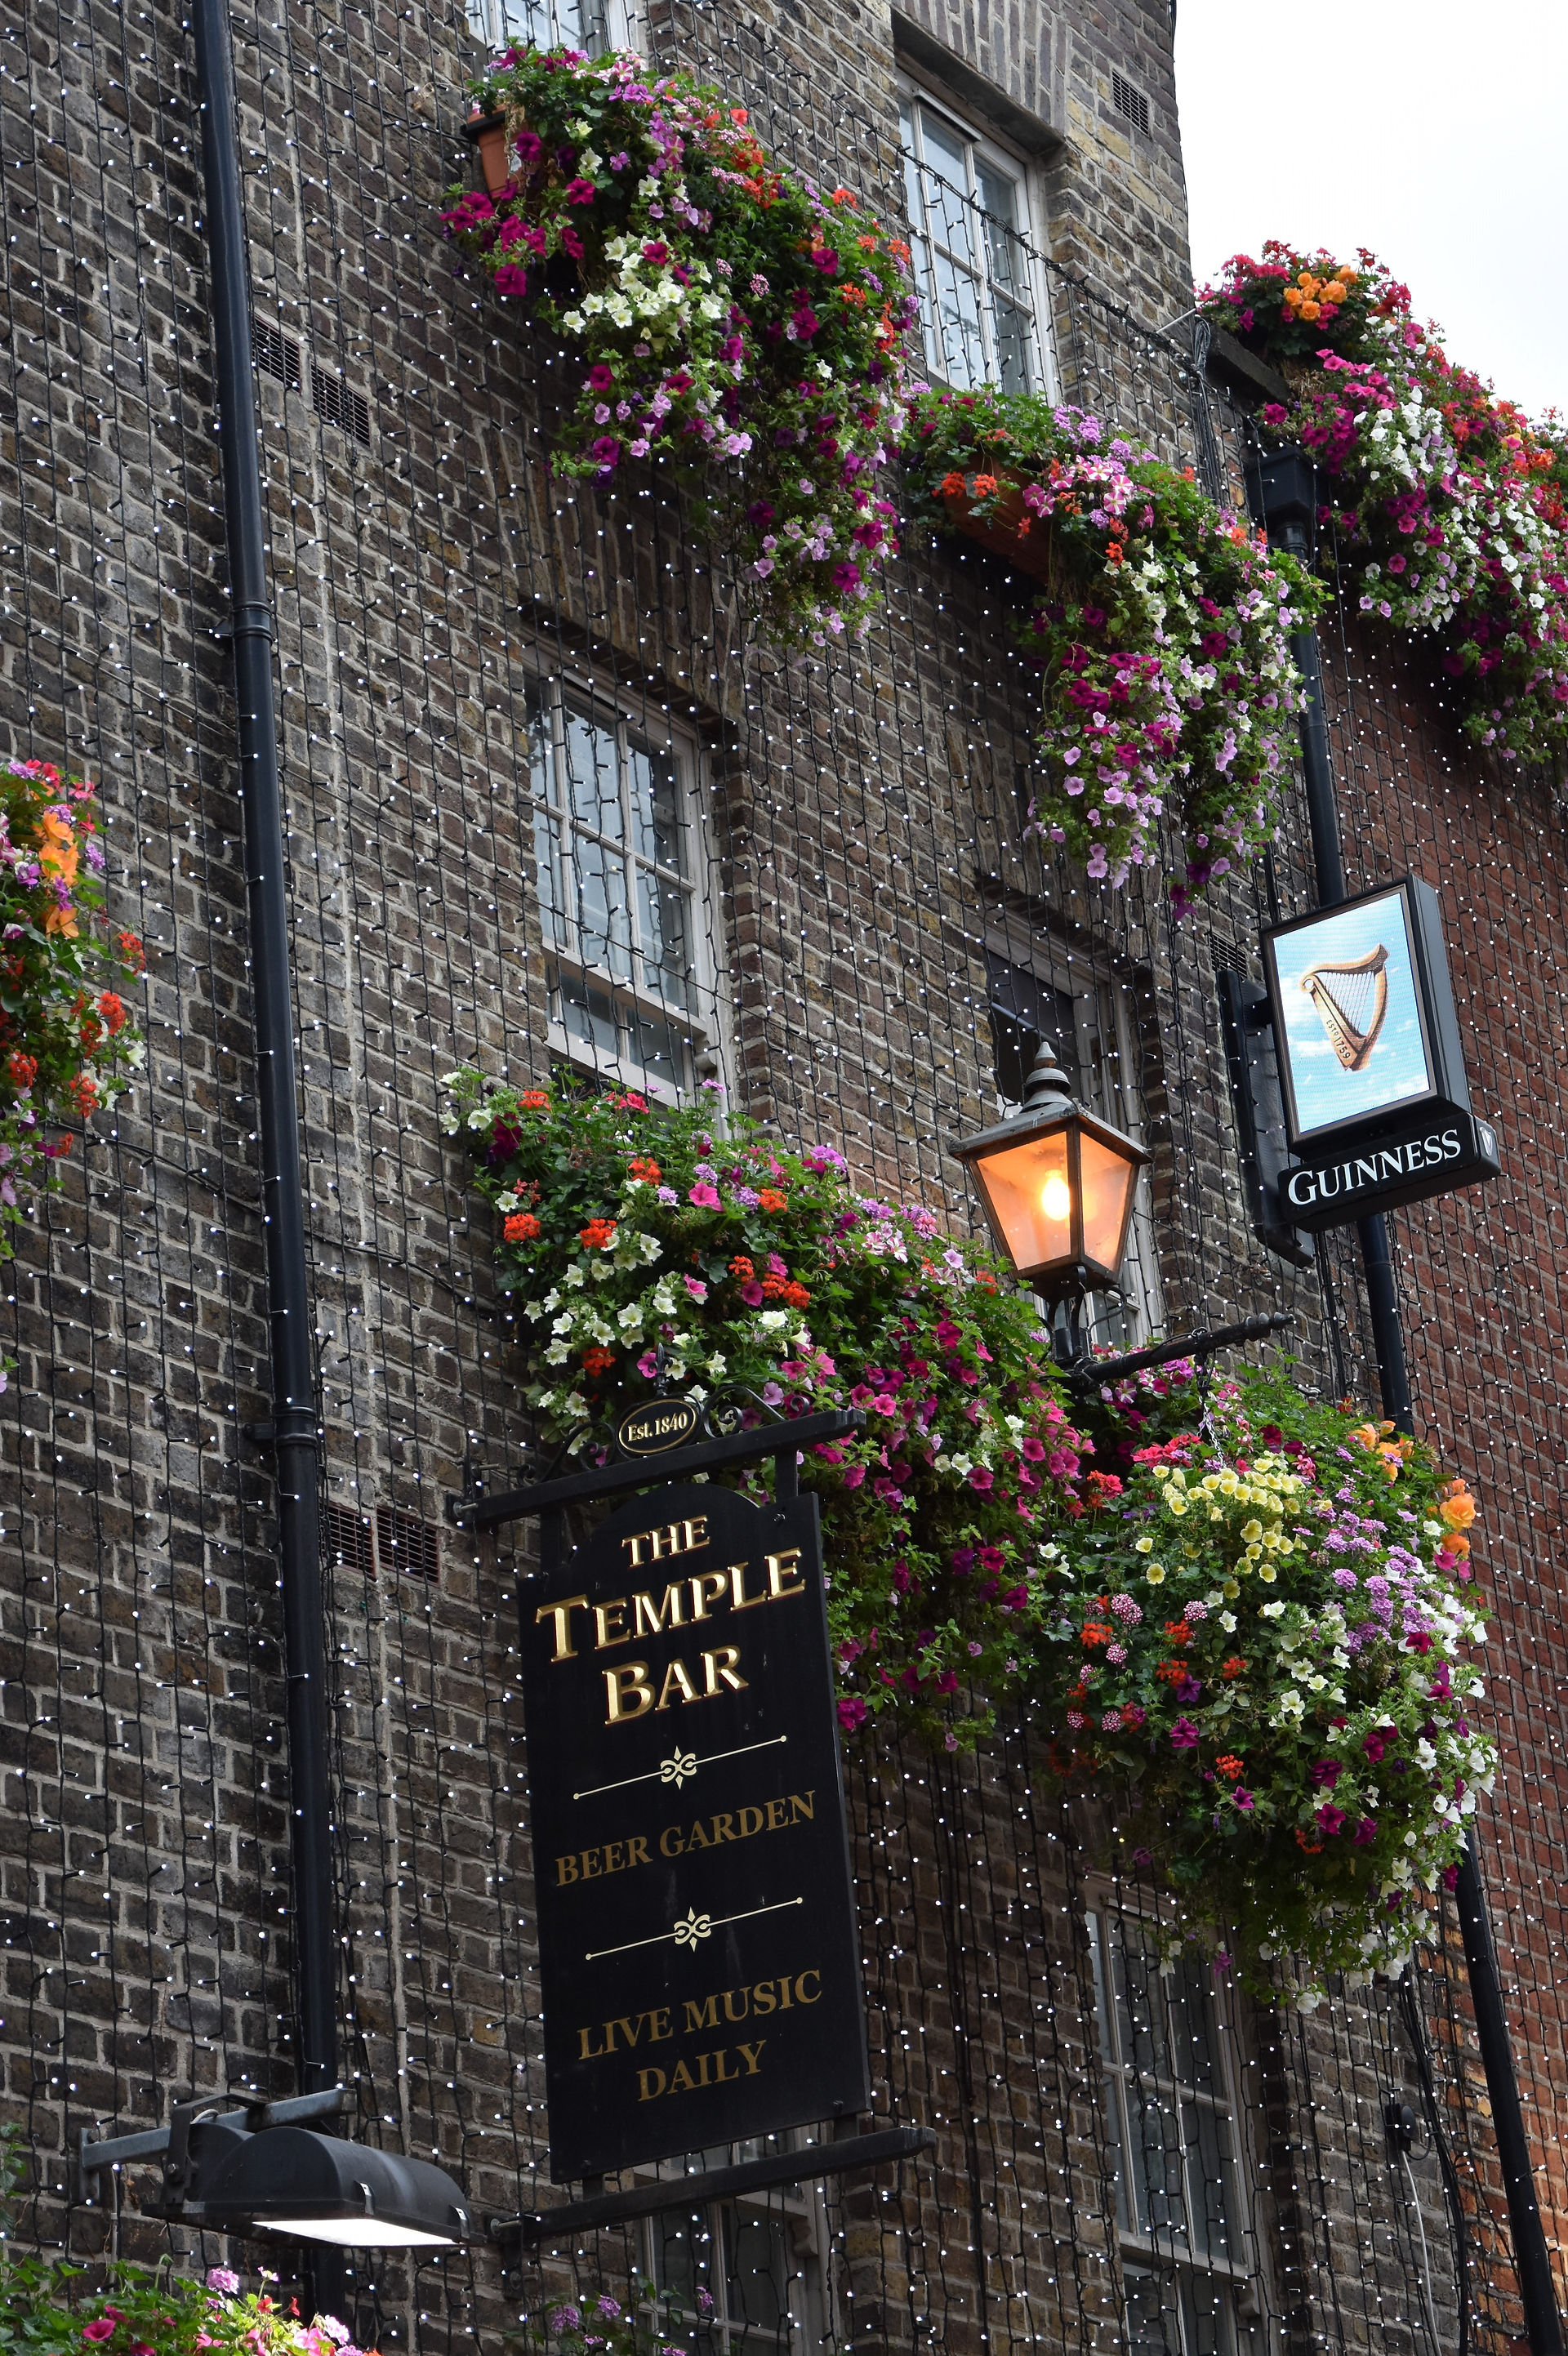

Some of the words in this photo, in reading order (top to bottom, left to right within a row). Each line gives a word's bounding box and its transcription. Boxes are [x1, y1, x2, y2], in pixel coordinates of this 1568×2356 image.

[1334, 1036, 1351, 1059] 1759
[1288, 1129, 1461, 1205] GUINNESS
[627, 1421, 653, 1442] Est.
[655, 1411, 688, 1436] 1840
[621, 1514, 710, 1568] THE
[535, 1546, 806, 1663] TEMPLE
[602, 1645, 749, 1726] BAR
[555, 1836, 653, 1886] BEER
[659, 1790, 816, 1858] GARDEN
[577, 2007, 673, 2060] LIVE
[681, 1969, 822, 2033] MUSIC
[636, 2040, 767, 2102] DAILY
